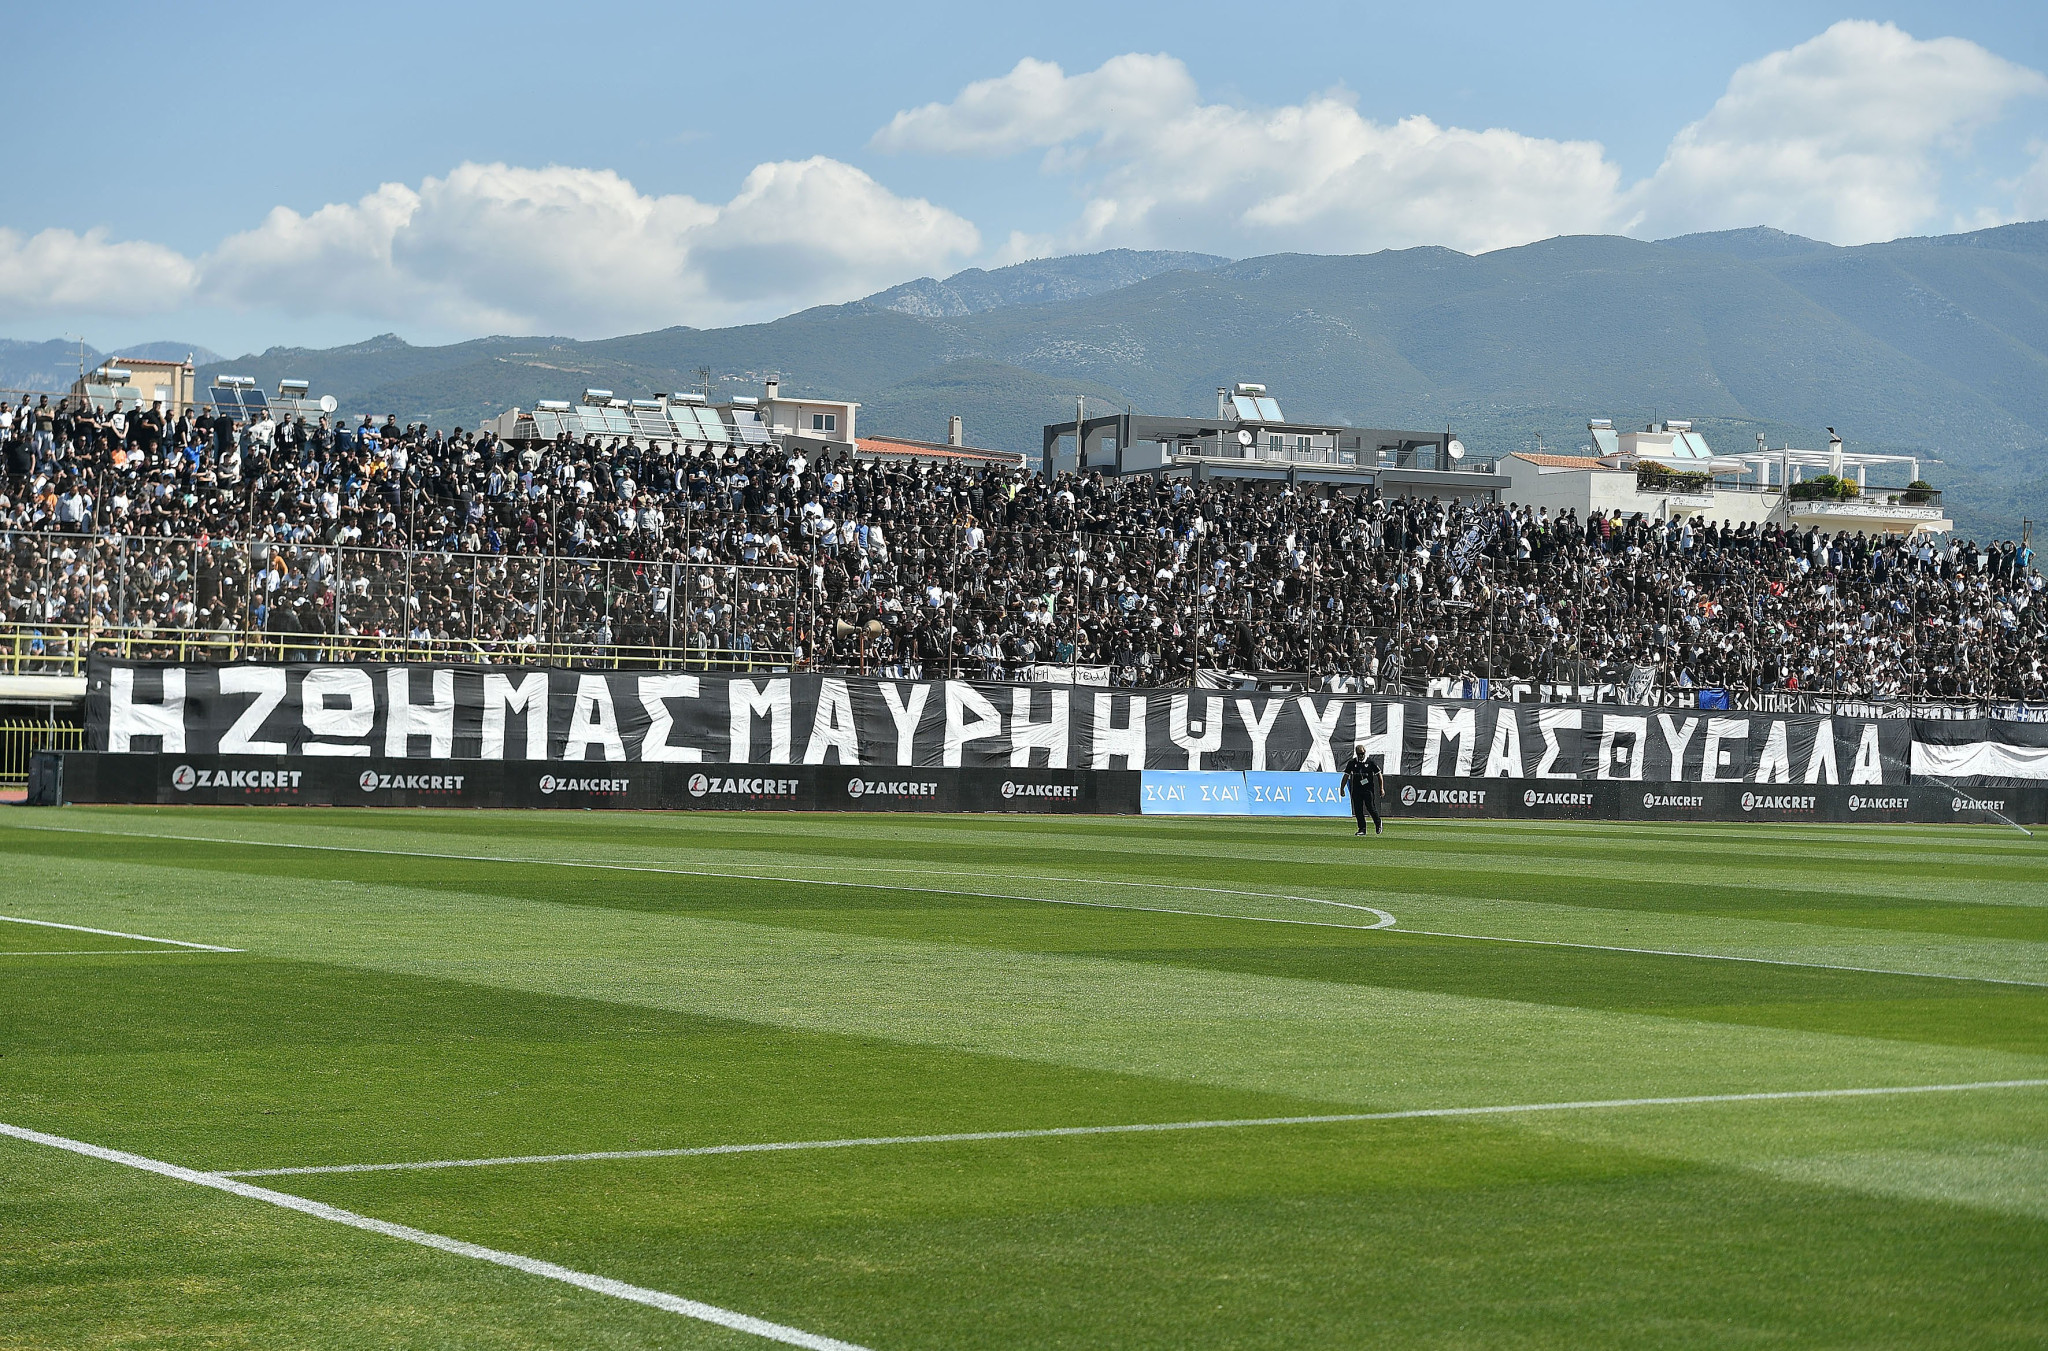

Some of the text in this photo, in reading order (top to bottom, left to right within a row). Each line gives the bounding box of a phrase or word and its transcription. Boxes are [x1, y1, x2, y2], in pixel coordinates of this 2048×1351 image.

[109, 668, 186, 754] Η
[1090, 693, 1147, 771] Η
[194, 770, 302, 788] ZAKCRET
[379, 774, 464, 790] ZAKCRET
[556, 778, 630, 792] ZAKCRET
[708, 777, 799, 795] ZAKCRET
[861, 781, 938, 795] ZAKCRET
[1015, 784, 1079, 797] ZAKCRET
[1417, 789, 1486, 804] ZAKCRET
[1534, 792, 1594, 805] ZAKCRET
[1651, 795, 1704, 807] ZAKCRET
[1754, 795, 1816, 809] ZAKCRET
[1857, 797, 1909, 809] ZAKCRET
